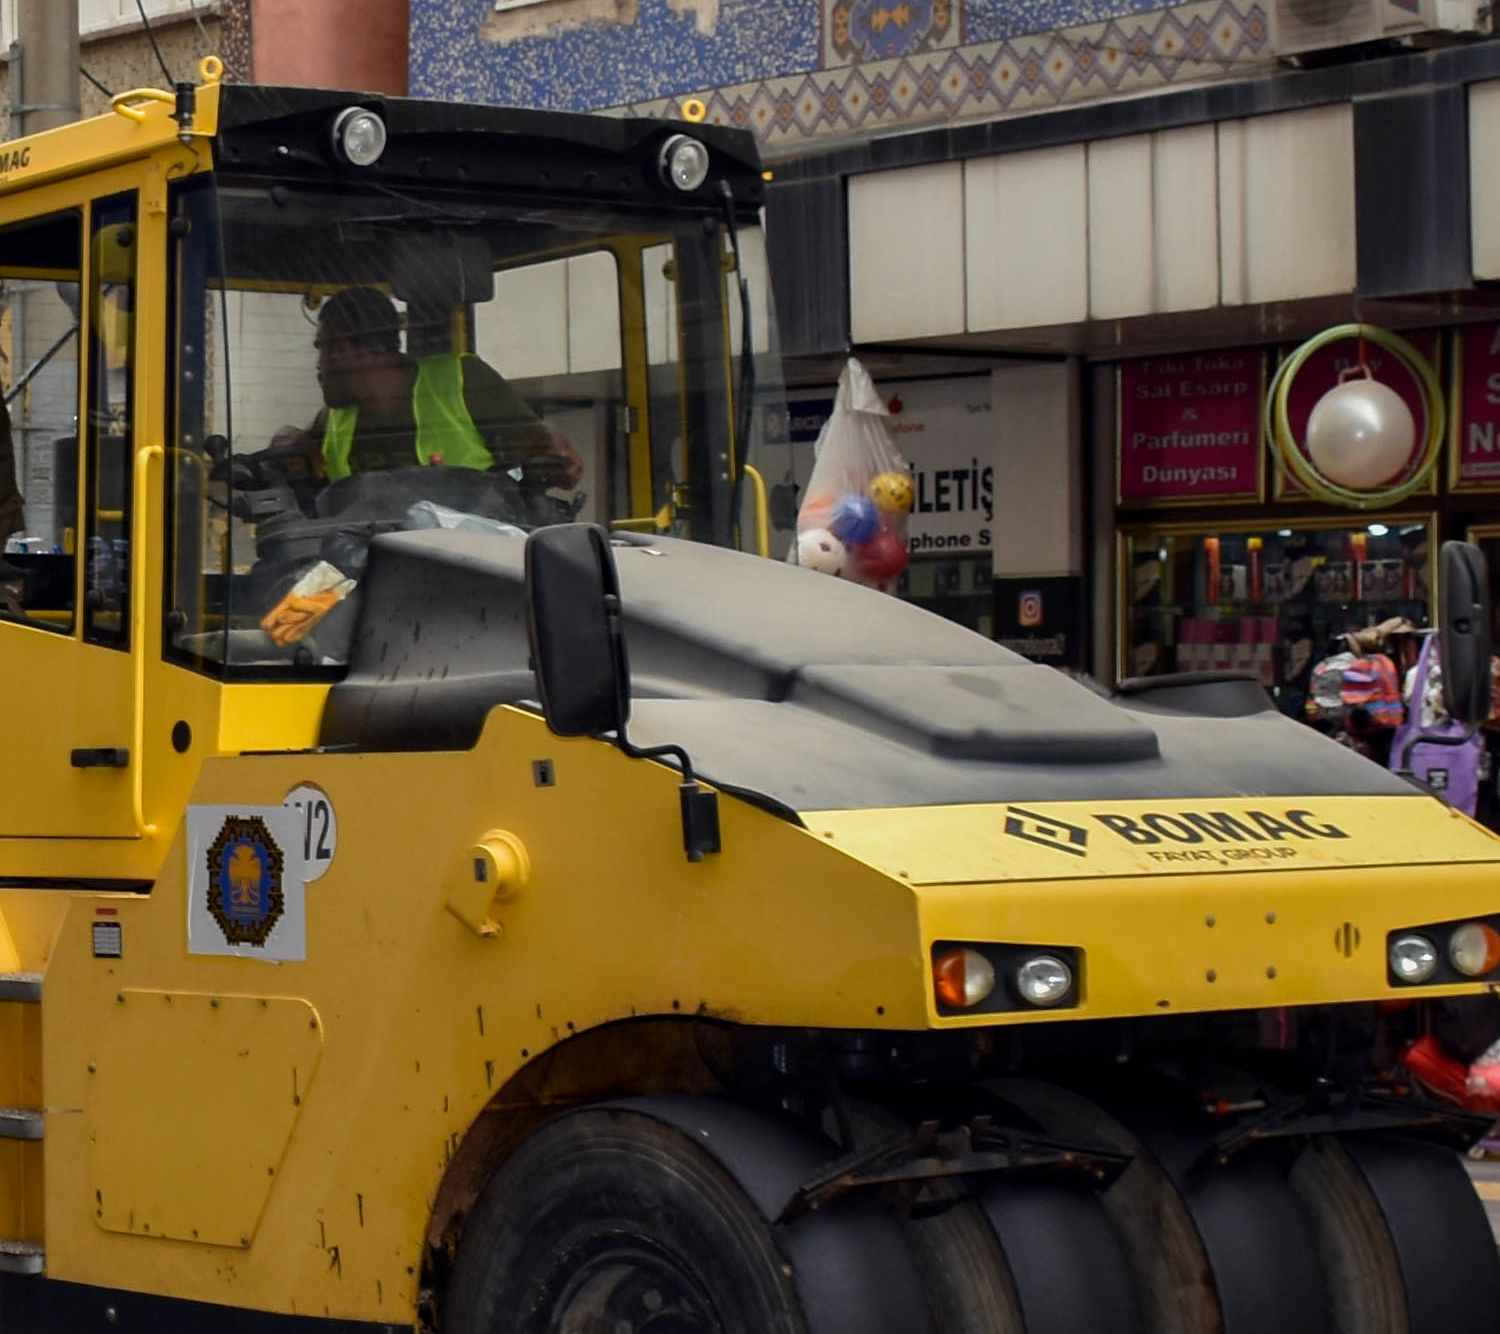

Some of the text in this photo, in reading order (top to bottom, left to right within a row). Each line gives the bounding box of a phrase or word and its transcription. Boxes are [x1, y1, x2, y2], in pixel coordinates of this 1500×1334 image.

[1091, 808, 1352, 845] BOMAG
[1147, 846, 1300, 863] FAYAT GROUP
